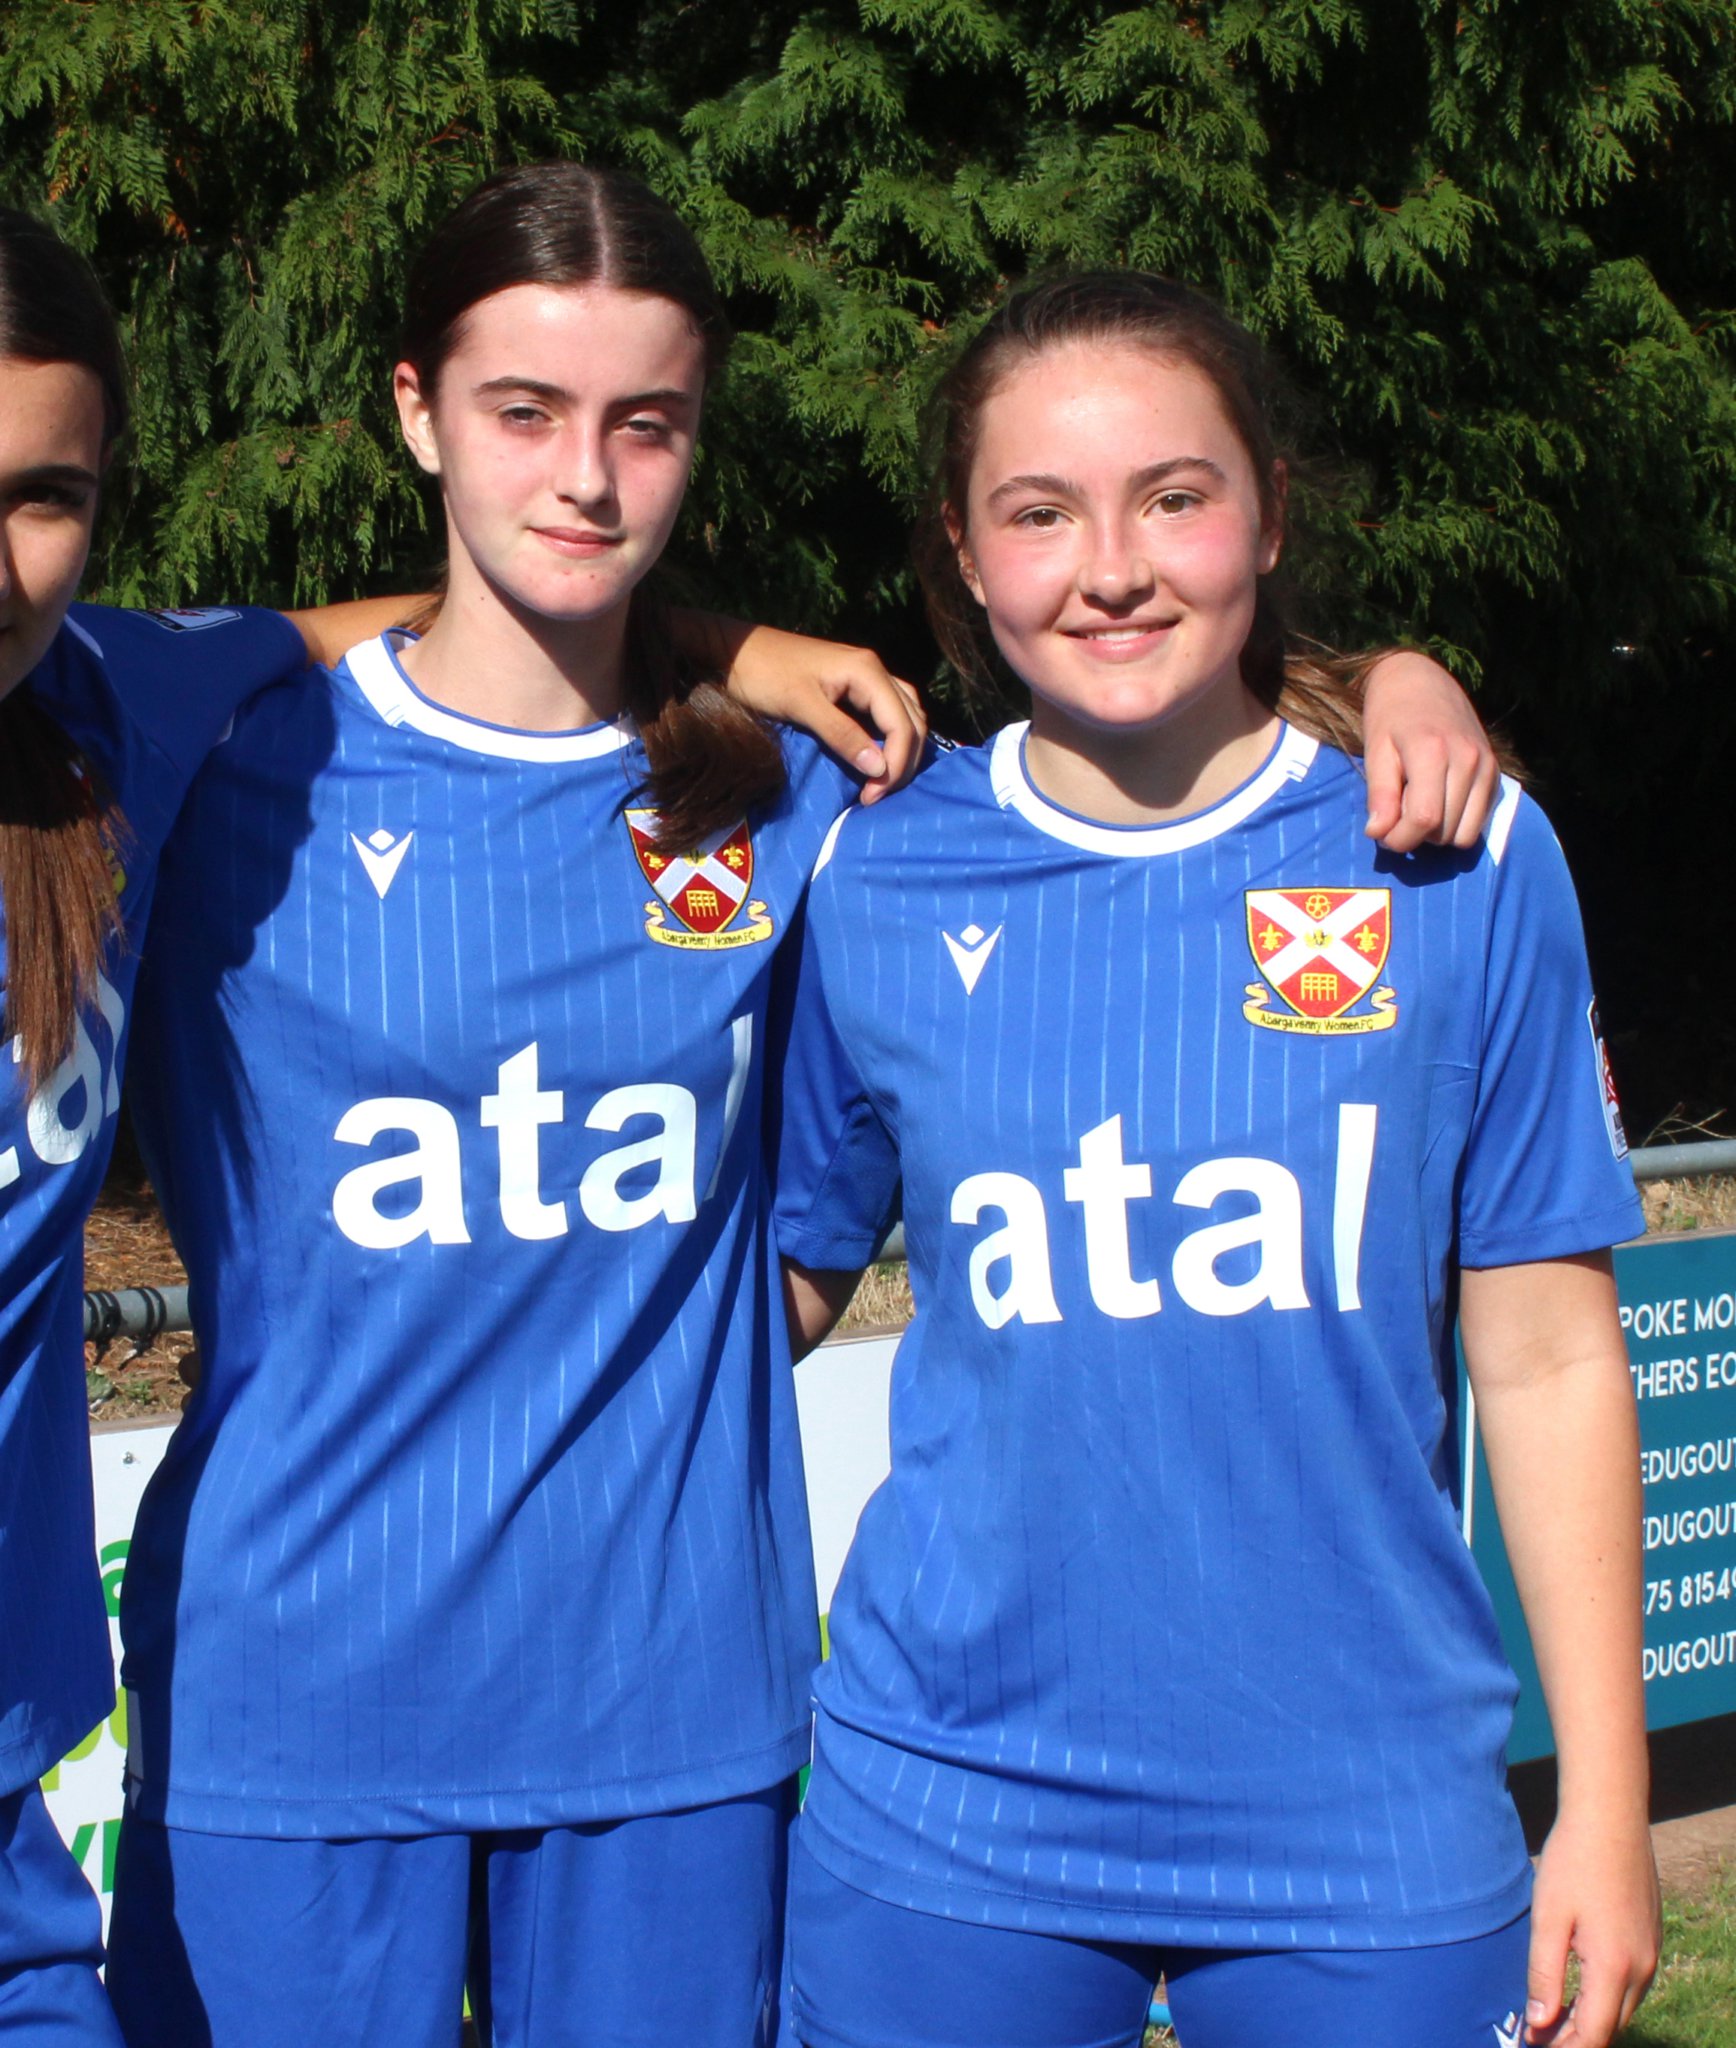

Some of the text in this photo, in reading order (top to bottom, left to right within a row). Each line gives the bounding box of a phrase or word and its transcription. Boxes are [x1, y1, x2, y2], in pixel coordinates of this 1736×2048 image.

[950, 1103, 1377, 1330] atal
[1694, 1292, 1736, 1332] MO
[1642, 1630, 1736, 1681] DUGOUT
